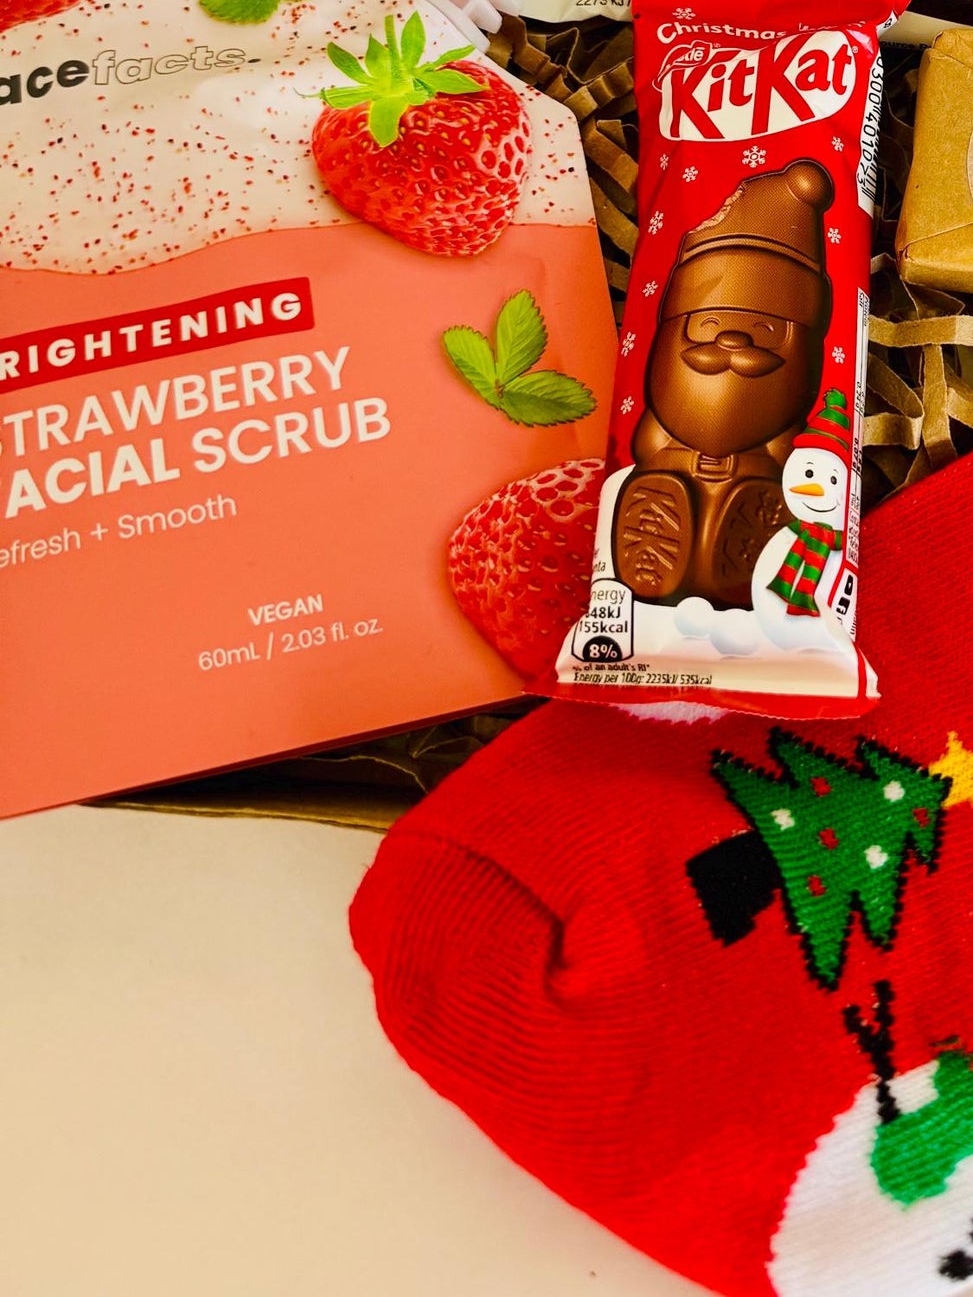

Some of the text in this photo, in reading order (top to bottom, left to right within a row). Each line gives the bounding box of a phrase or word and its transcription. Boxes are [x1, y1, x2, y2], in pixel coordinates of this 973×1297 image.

[656, 21, 788, 45] Christmas
[0, 291, 301, 381] RIGHTENING
[0, 346, 350, 459] TRAWBERRY
[0, 396, 392, 520] ACIAL SCRUB
[0, 493, 238, 569] efresh + Smooth
[247, 593, 325, 626] VEGAN
[591, 588, 627, 605] nergy
[197, 616, 385, 672] 60mL / 2.03 fl. oz.
[588, 643, 619, 659] 8%
[573, 671, 602, 684] Energy
[603, 673, 620, 684] per
[607, 663, 636, 672] adult's
